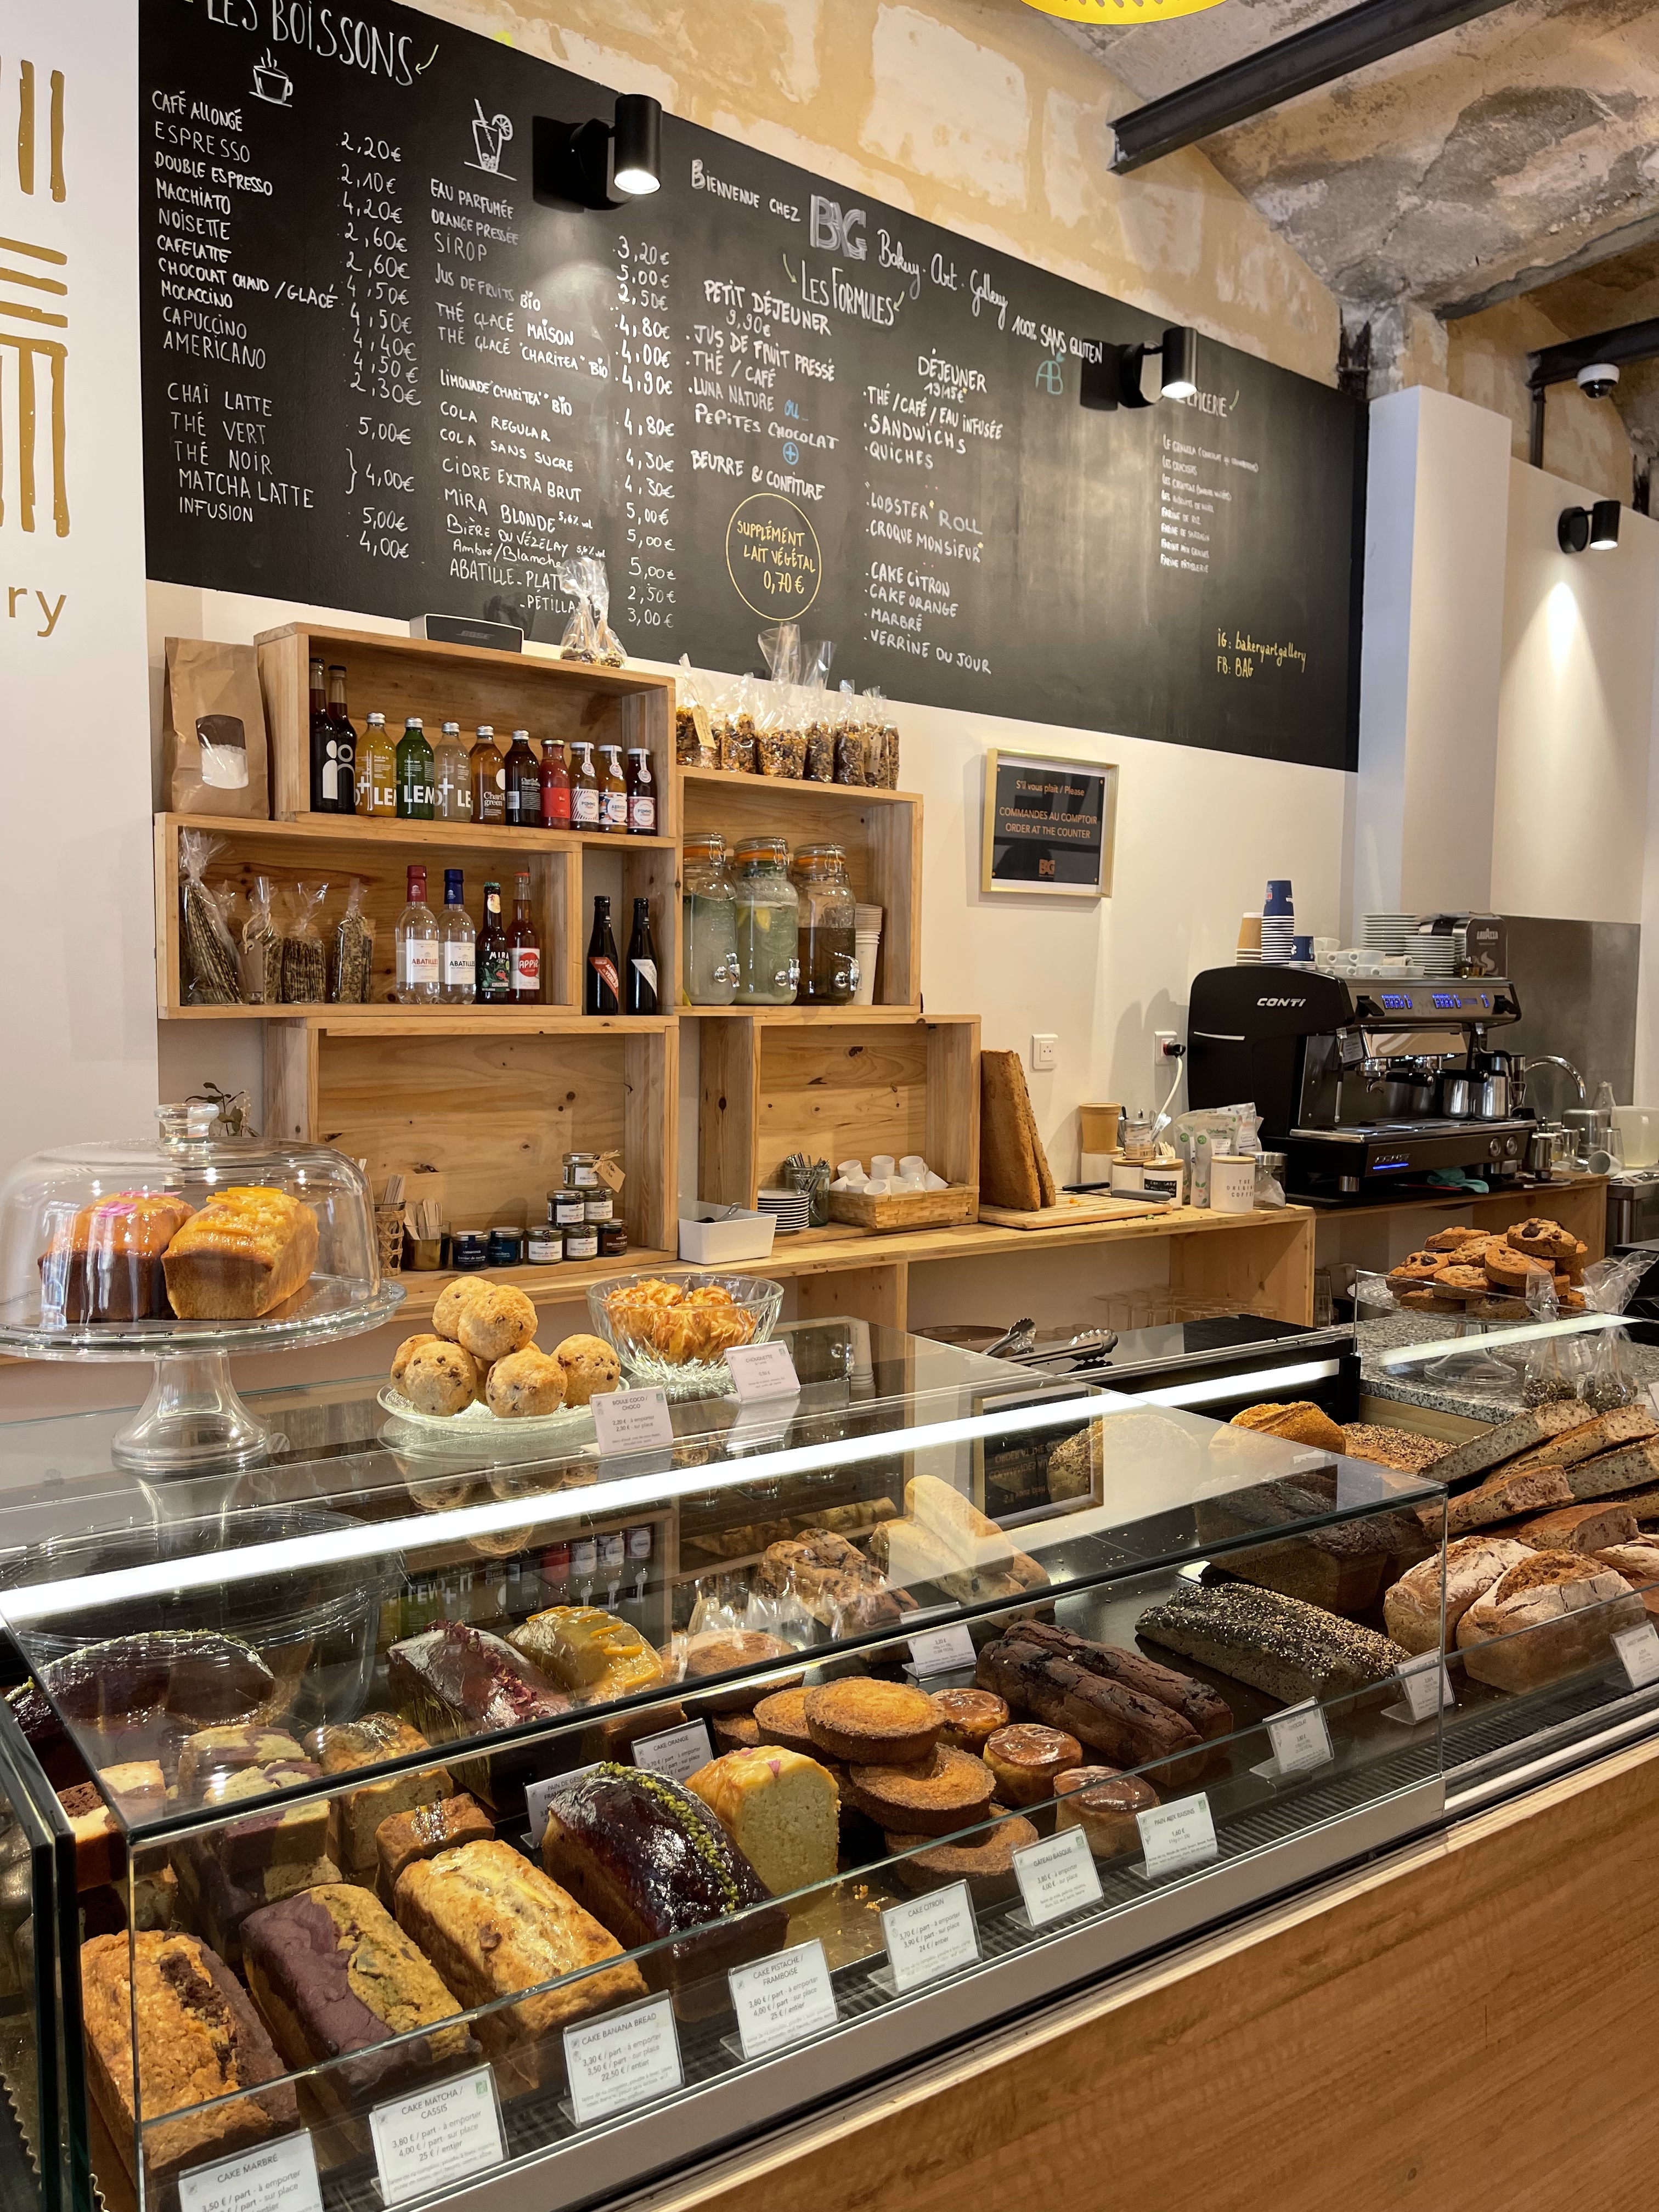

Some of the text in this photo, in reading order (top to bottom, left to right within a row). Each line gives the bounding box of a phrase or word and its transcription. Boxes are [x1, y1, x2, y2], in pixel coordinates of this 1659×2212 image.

[153, 90, 186, 115] CAFÉ
[155, 121, 250, 162] ESPRESSO
[155, 151, 273, 195] DOUBLE ESPRESSO
[431, 178, 514, 219] EAU PARFUMÉE
[769, 198, 801, 222] CHEZ
[431, 208, 519, 245] ORANGE PRESSÉE
[158, 257, 227, 285] CHOCOLAT
[435, 262, 454, 286] JUS
[802, 260, 894, 326] LES FORMULES
[436, 302, 464, 323] THÉ
[473, 313, 514, 332] GLACÉ
[751, 290, 832, 336] DÉJEUNER
[163, 330, 266, 369] AMERICANO
[438, 326, 511, 355] THÉ GLACÉ
[694, 324, 724, 348] JUS
[730, 332, 748, 353] DE
[795, 353, 835, 382] PRESSÉ
[1040, 324, 1103, 364] SANS GLUTEN
[692, 349, 776, 388] THÉ CAFÉ
[918, 348, 988, 393] DÉJEUNER
[225, 391, 272, 417] LATTE
[693, 376, 775, 413] LUNA NATURE
[867, 383, 890, 405] THÉ
[939, 407, 959, 427] EAU
[171, 411, 266, 444] THÉ VERT
[440, 400, 550, 442] COLA REGULAR
[439, 428, 574, 472] COLA SANS SUCRE
[768, 422, 839, 450] CHOCOLAT
[174, 441, 209, 465] THÉ
[690, 450, 744, 477] BEURRE
[179, 469, 314, 509] MATCHA LATTE
[497, 468, 542, 493] EXTRA
[548, 481, 582, 503] BRUT
[179, 496, 253, 522] INFUSION
[500, 504, 556, 533] BLONDE
[871, 492, 983, 535] LOBSTER ROLL
[870, 520, 912, 545] CROQUE
[771, 546, 816, 573] VÉGÉTAL
[871, 562, 904, 583] CAKE
[870, 583, 958, 618] CAKE ORANGE
[871, 608, 923, 632] MARBRÉ
[935, 647, 952, 662] DU
[957, 652, 991, 674] JOUR
[1235, 631, 1307, 673] bakeryartgallery
[1235, 657, 1253, 678] BAG
[1016, 780, 1085, 796] S'il vous Please
[1000, 807, 1097, 825] COMMANDES AU COMPTOIR
[1006, 823, 1030, 833] ORDER
[1042, 827, 1056, 835] THE
[1057, 827, 1090, 838] COUNTER
[1256, 997, 1306, 1008] CONTI
[653, 1735, 689, 1751] CAKE ORANGE
[1177, 1808, 1195, 1819] RAISINS
[1053, 1847, 1072, 1859] BASQUE
[908, 1898, 944, 1917] CAKE CITRON
[753, 1956, 799, 1979] CAKE PISTACHE
[763, 1967, 798, 1985] FRAMBOISE
[582, 2013, 656, 2045] CAKE BANANA BREAD
[402, 2089, 458, 2115] CAKE MATCHA
[421, 2103, 447, 2119] CASSIS
[422, 2111, 481, 2138] part emporter
[460, 2123, 478, 2136] place
[217, 2153, 278, 2183] CAKE MARBRÉ
[235, 2170, 301, 2202] part emporter
[278, 2183, 298, 2199] place
